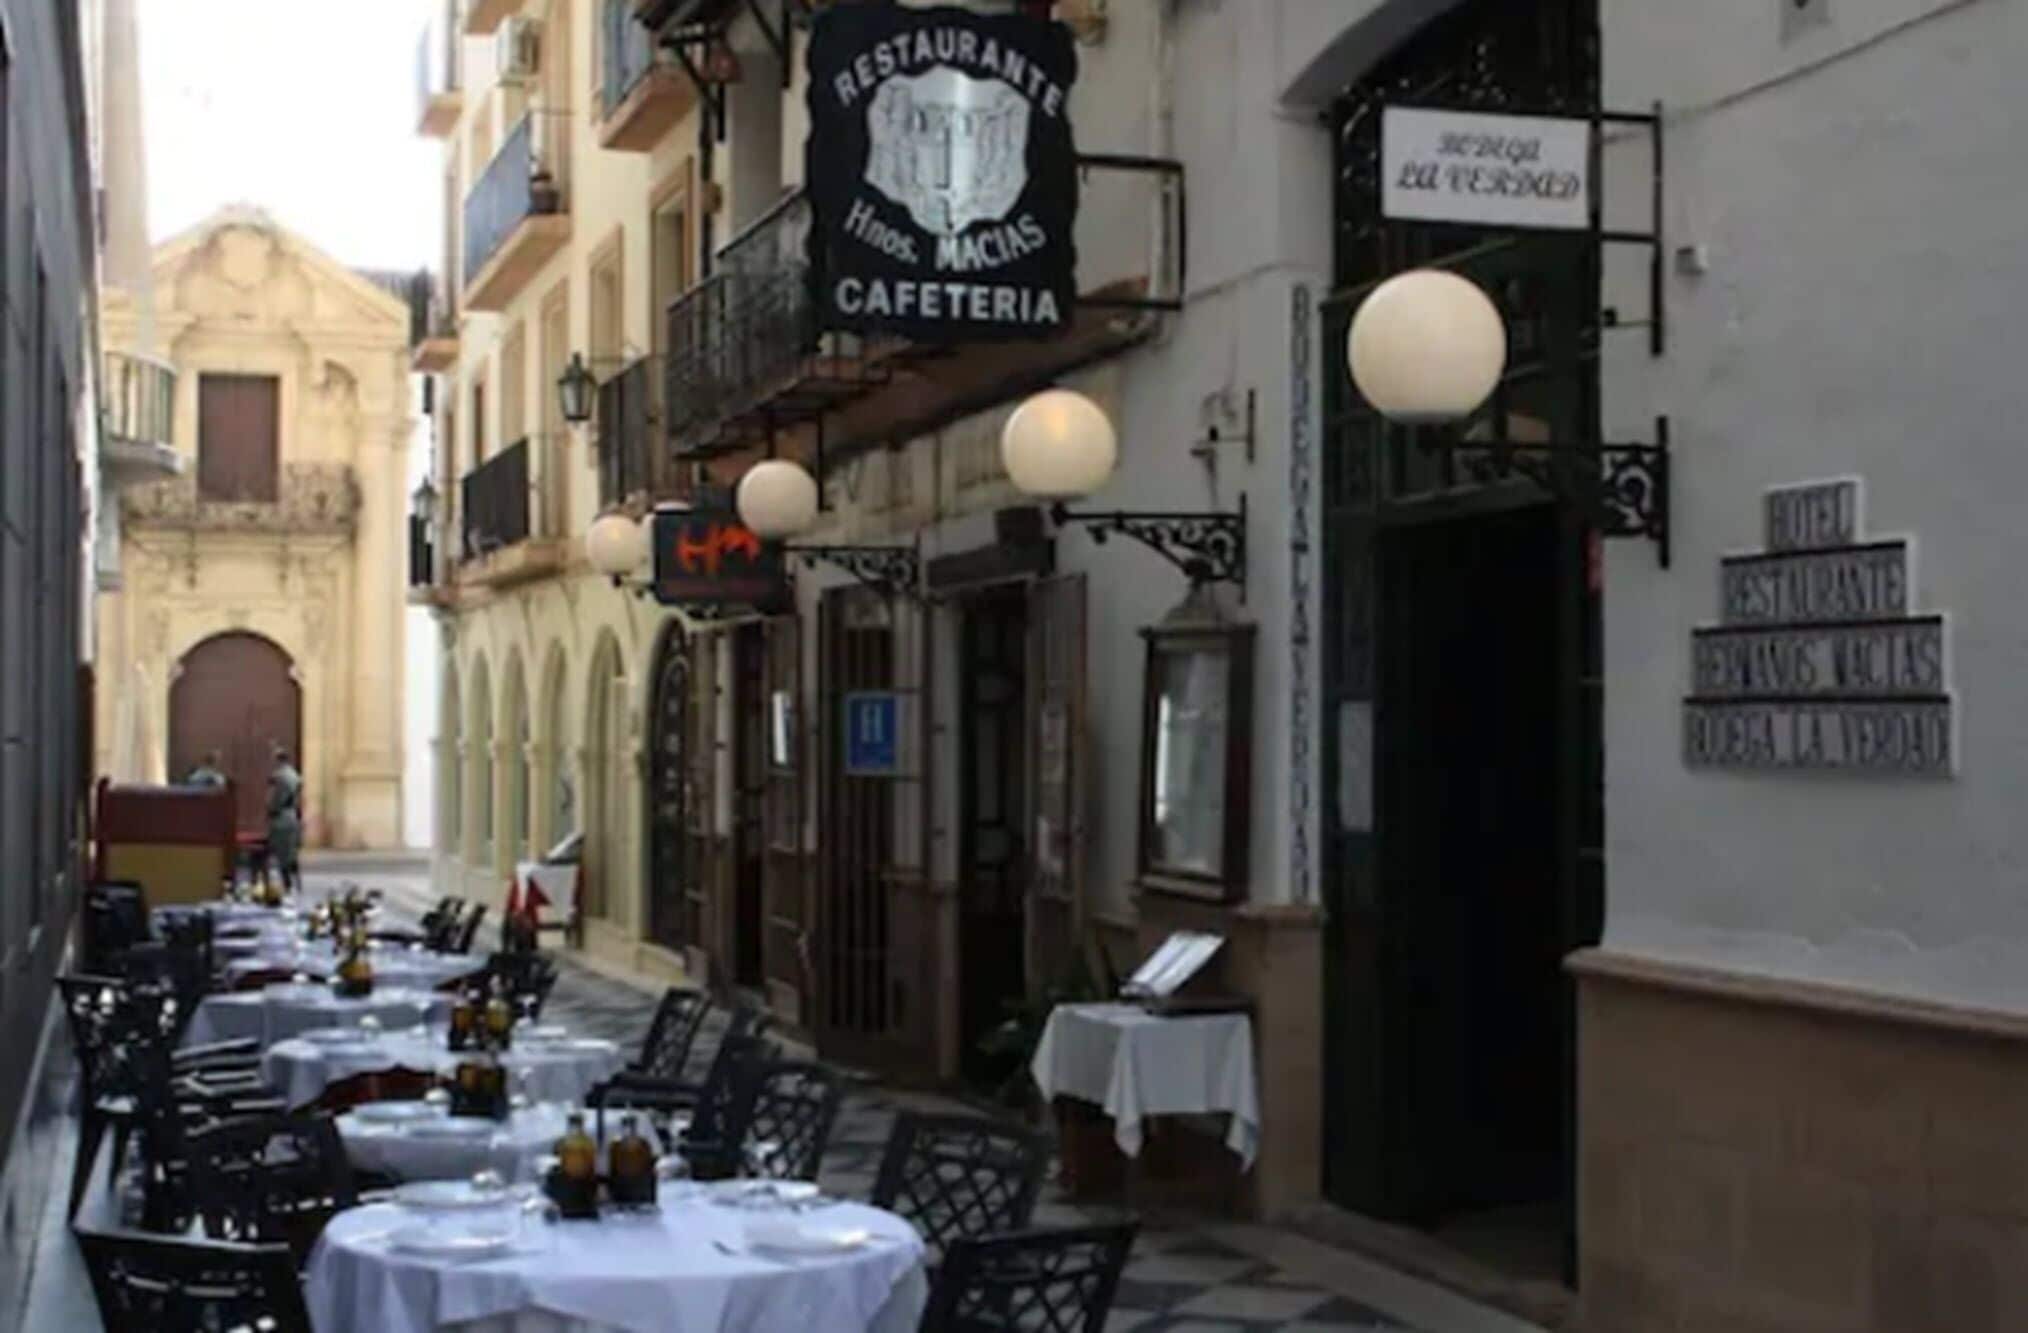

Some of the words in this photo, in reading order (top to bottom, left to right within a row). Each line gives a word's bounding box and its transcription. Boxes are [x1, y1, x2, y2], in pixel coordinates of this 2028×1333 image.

[834, 27, 1062, 117] RESTAURANTE
[845, 199, 919, 264] Hnos.
[935, 213, 1047, 272] MACIAS
[836, 277, 1059, 324] CAFETERIA
[1724, 554, 1906, 618] RESTAURANTE
